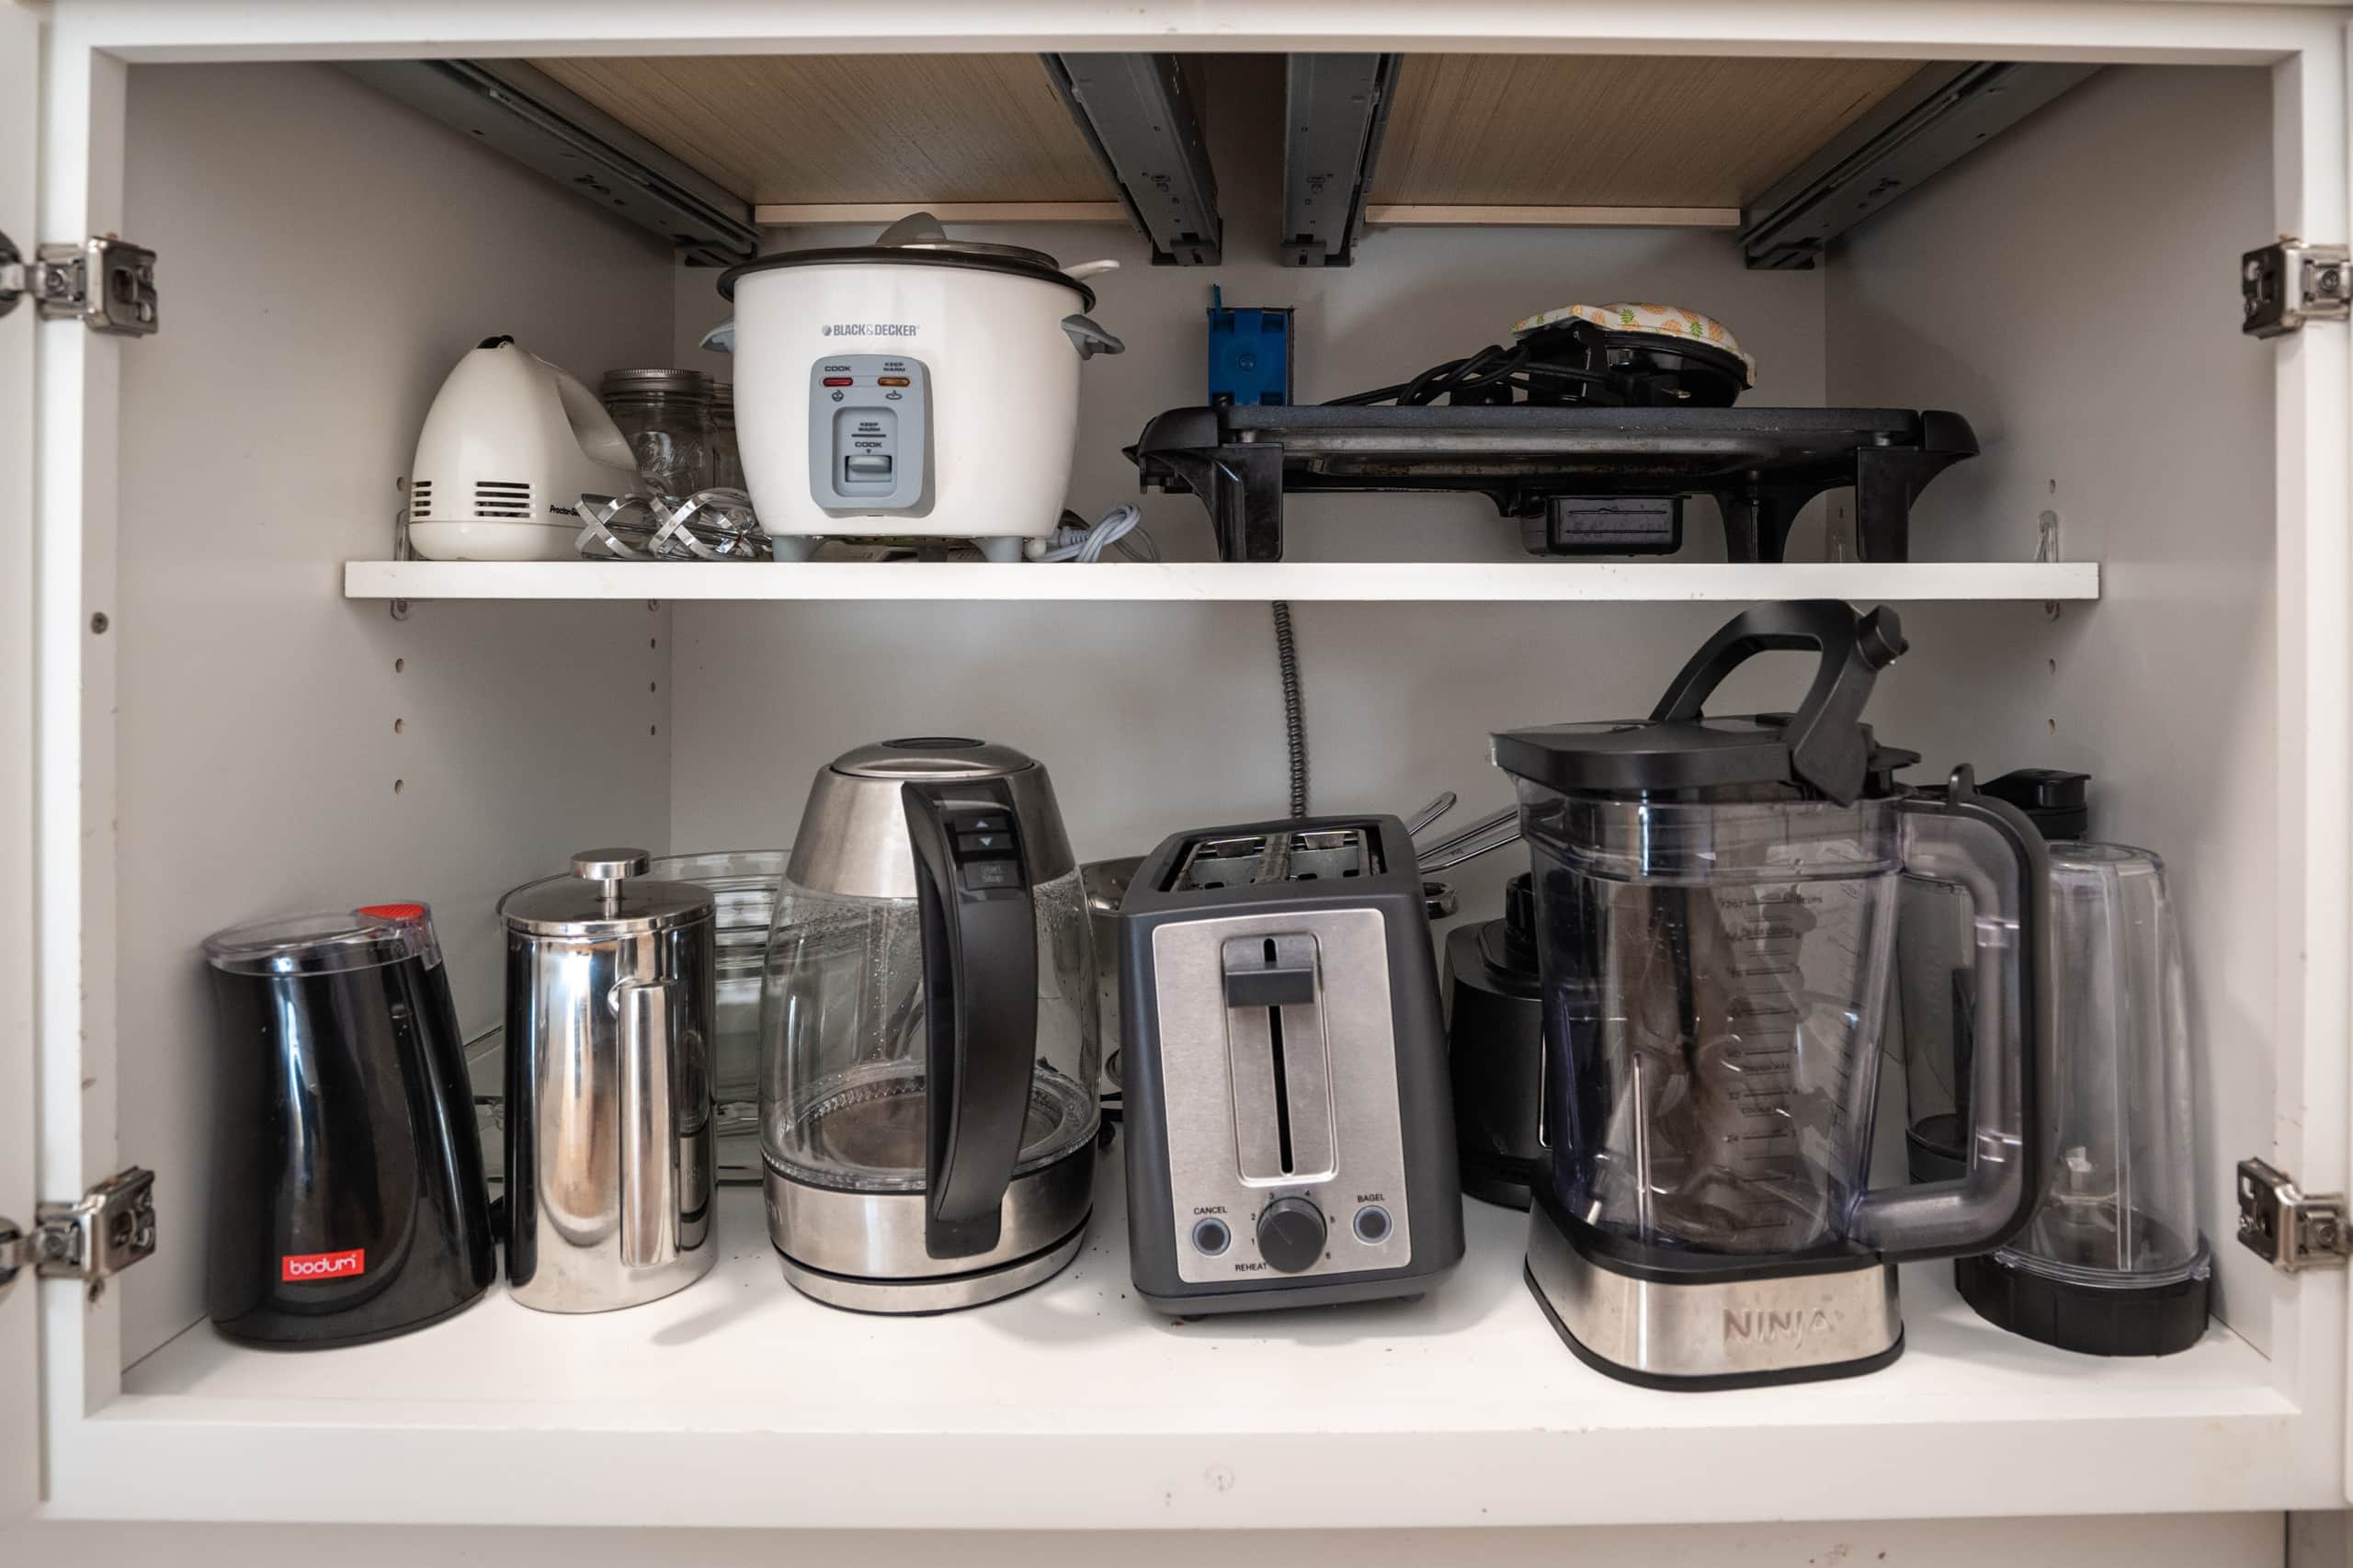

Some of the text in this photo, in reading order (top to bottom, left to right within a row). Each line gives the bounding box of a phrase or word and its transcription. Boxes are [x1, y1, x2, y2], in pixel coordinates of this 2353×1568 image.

[1357, 1194, 1385, 1203] BAGEL
[1193, 1205, 1228, 1215] CANCEL
[290, 1256, 357, 1276] bodum
[1234, 1263, 1267, 1272] REHEAT
[1723, 1308, 1836, 1352] NINJA
